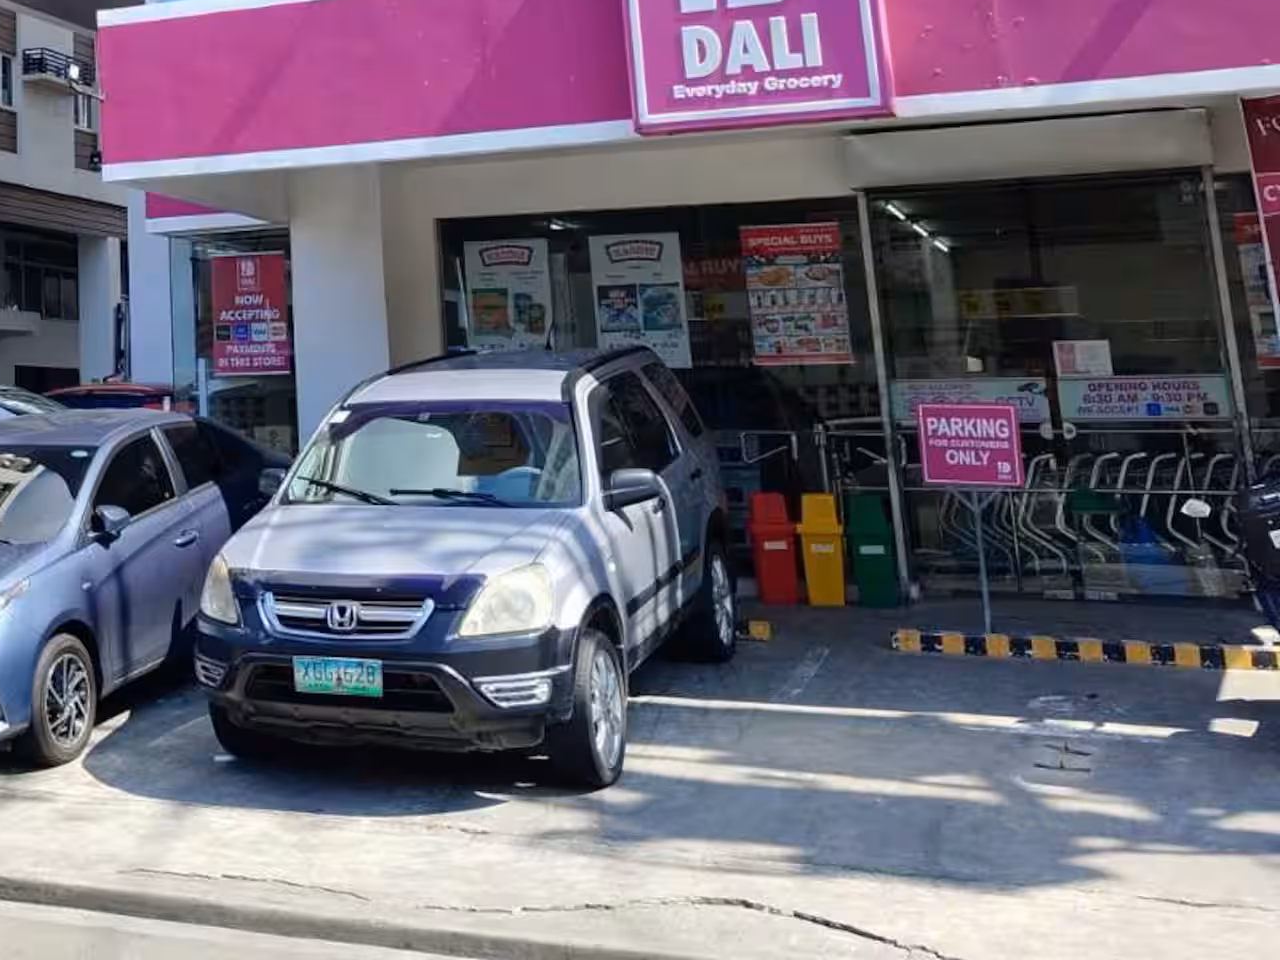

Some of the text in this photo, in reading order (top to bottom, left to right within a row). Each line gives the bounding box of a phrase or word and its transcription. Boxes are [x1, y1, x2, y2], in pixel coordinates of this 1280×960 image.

[681, 12, 823, 79] DALI
[673, 73, 843, 99] Everyday Grocery
[747, 234, 833, 246] SPECIAL BUYS
[234, 294, 264, 305] NOW
[220, 309, 280, 320] ACCEPTING
[226, 344, 276, 353] PAYMENTS
[230, 357, 251, 367] THIS
[1087, 381, 1201, 393] OPENING HOURS
[1117, 393, 1139, 403] AM
[1187, 392, 1208, 402] PM
[926, 417, 1010, 438] PARKING
[929, 439, 1010, 449] FOR CUSTOMERS
[945, 450, 991, 465] ONLY
